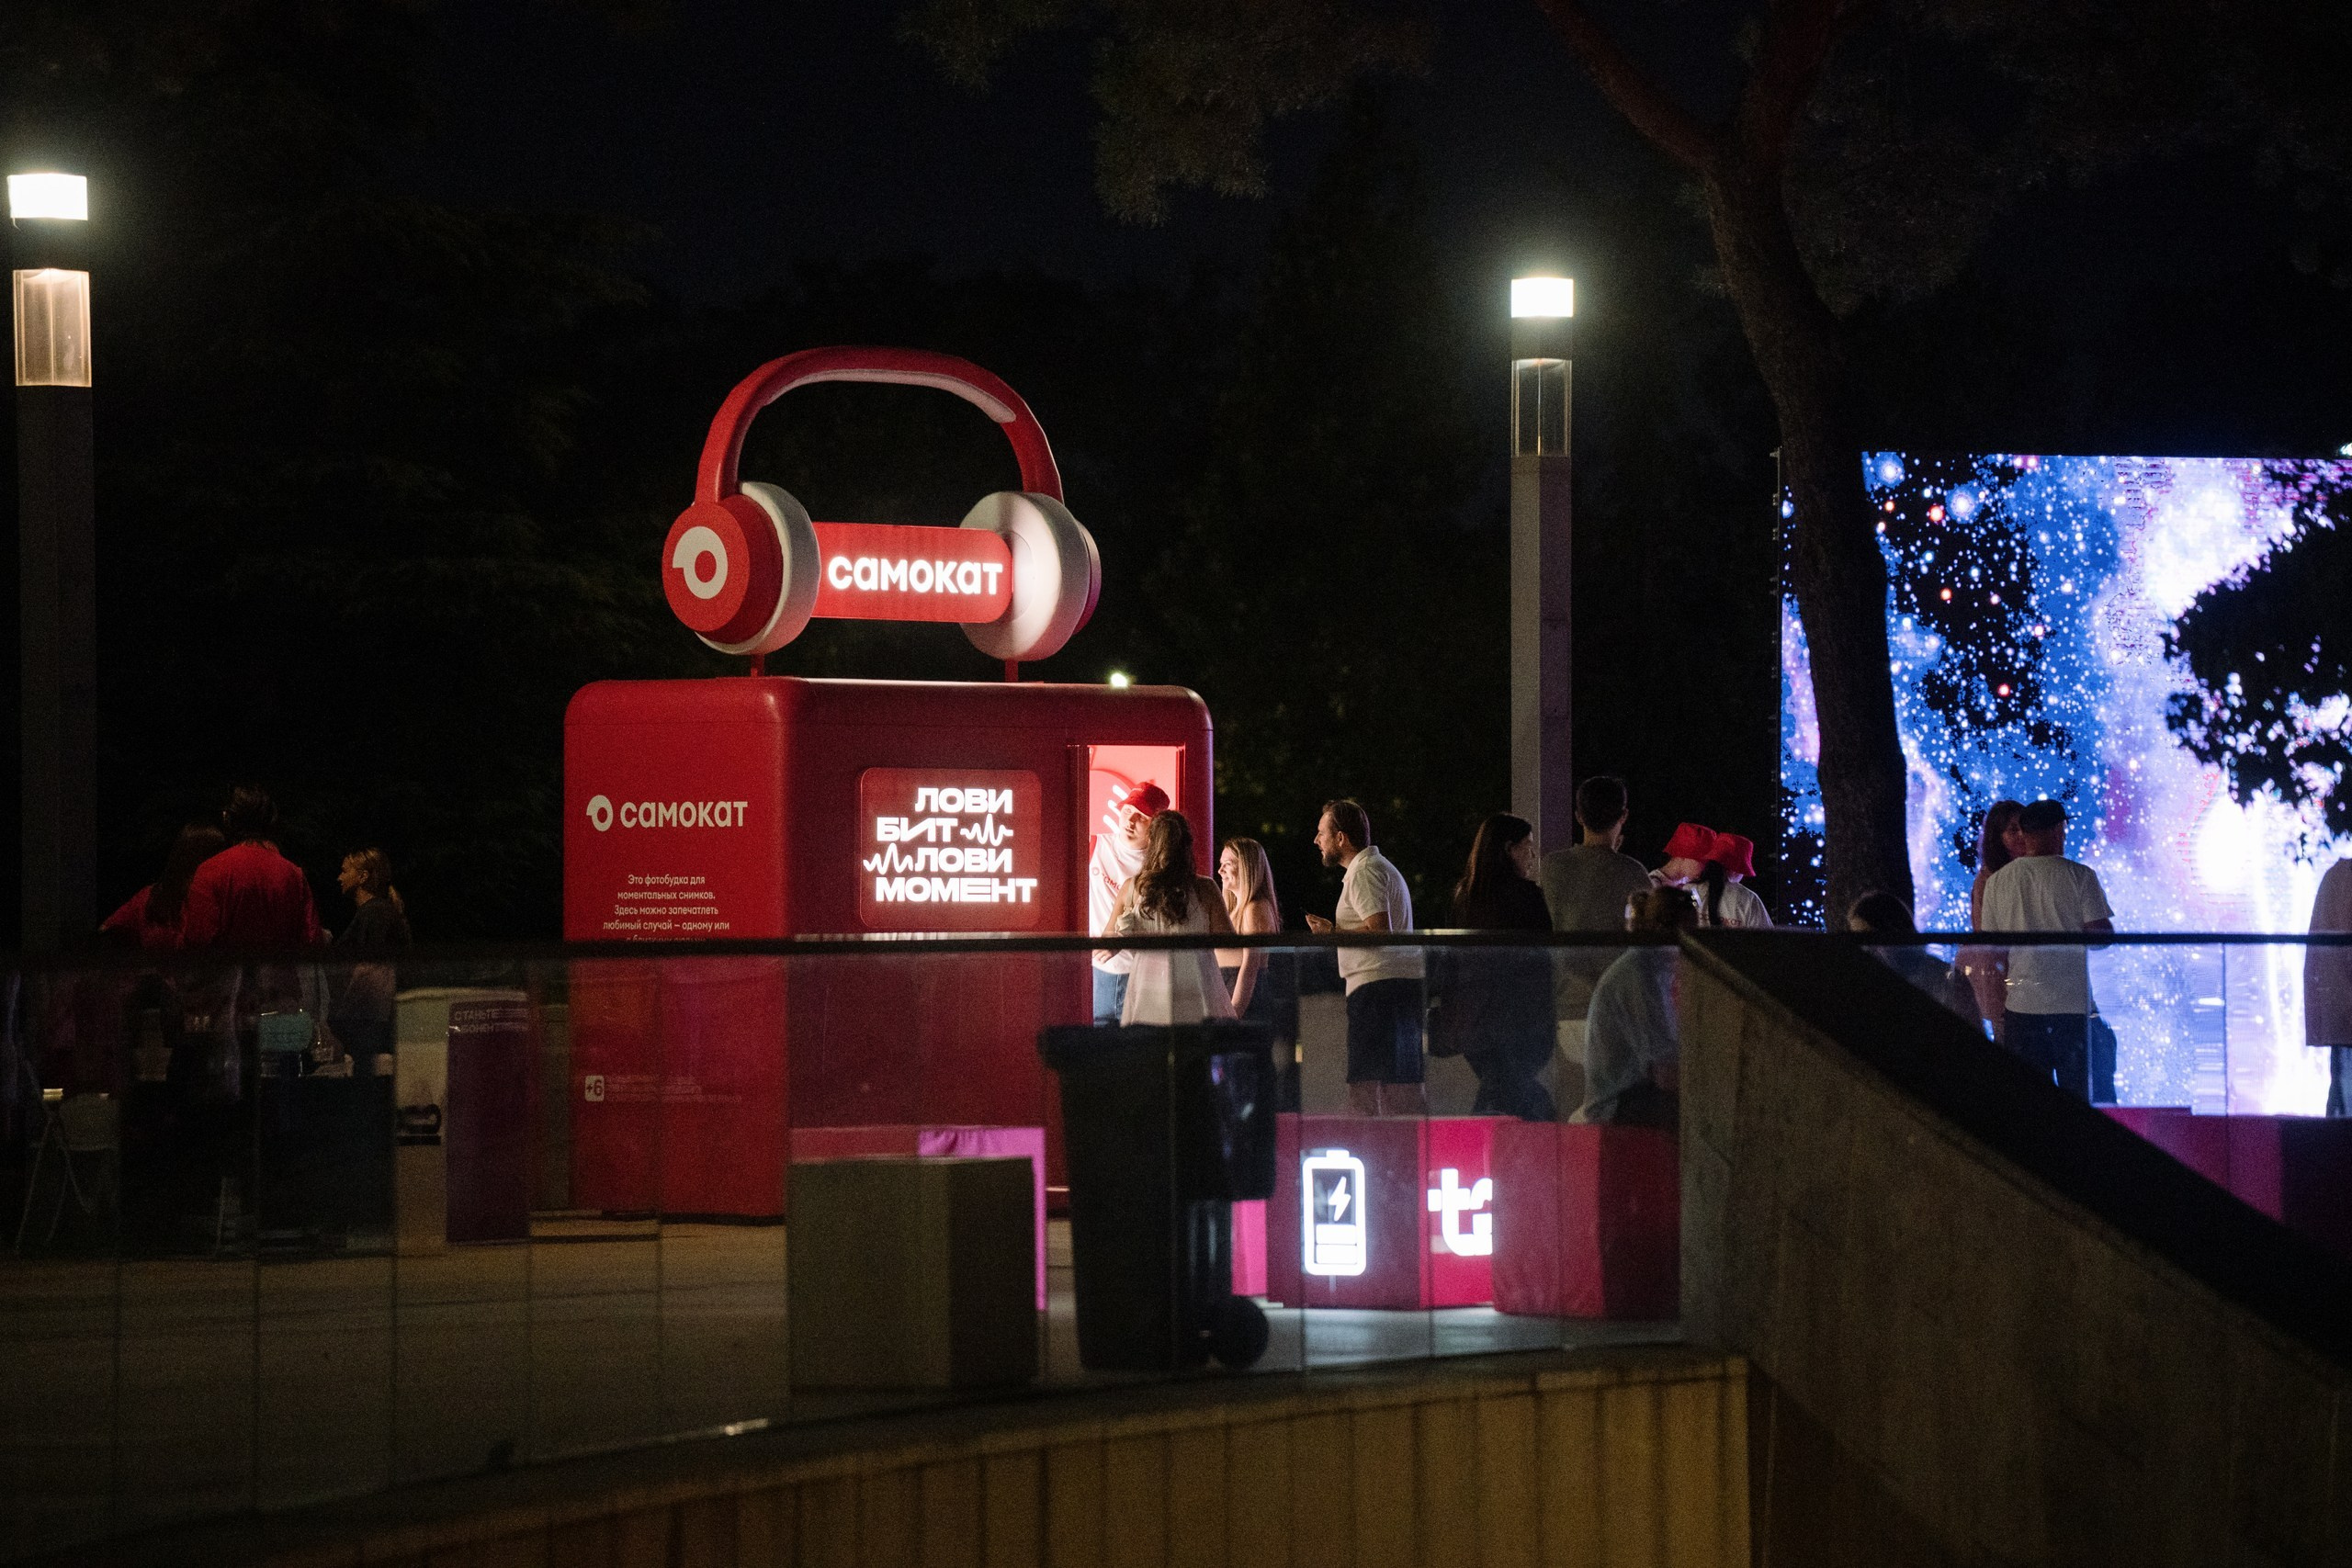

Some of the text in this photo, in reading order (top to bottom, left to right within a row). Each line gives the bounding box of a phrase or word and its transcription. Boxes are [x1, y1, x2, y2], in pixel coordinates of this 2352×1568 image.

[828, 555, 1003, 595] самокат
[915, 787, 1013, 814] ЛОВИ
[620, 801, 748, 829] самокат
[876, 817, 958, 842] БИТ
[914, 847, 1012, 873] ЛОВИ
[628, 874, 706, 886] Это фотобудка для
[876, 876, 1037, 903] МОМЕНТ
[617, 891, 716, 899] моментальных снимков.
[614, 904, 718, 916] Здесь можно запечатлеть
[603, 919, 641, 930] любимый
[643, 919, 673, 932] случай
[682, 921, 713, 932] одному
[714, 921, 729, 930] или
